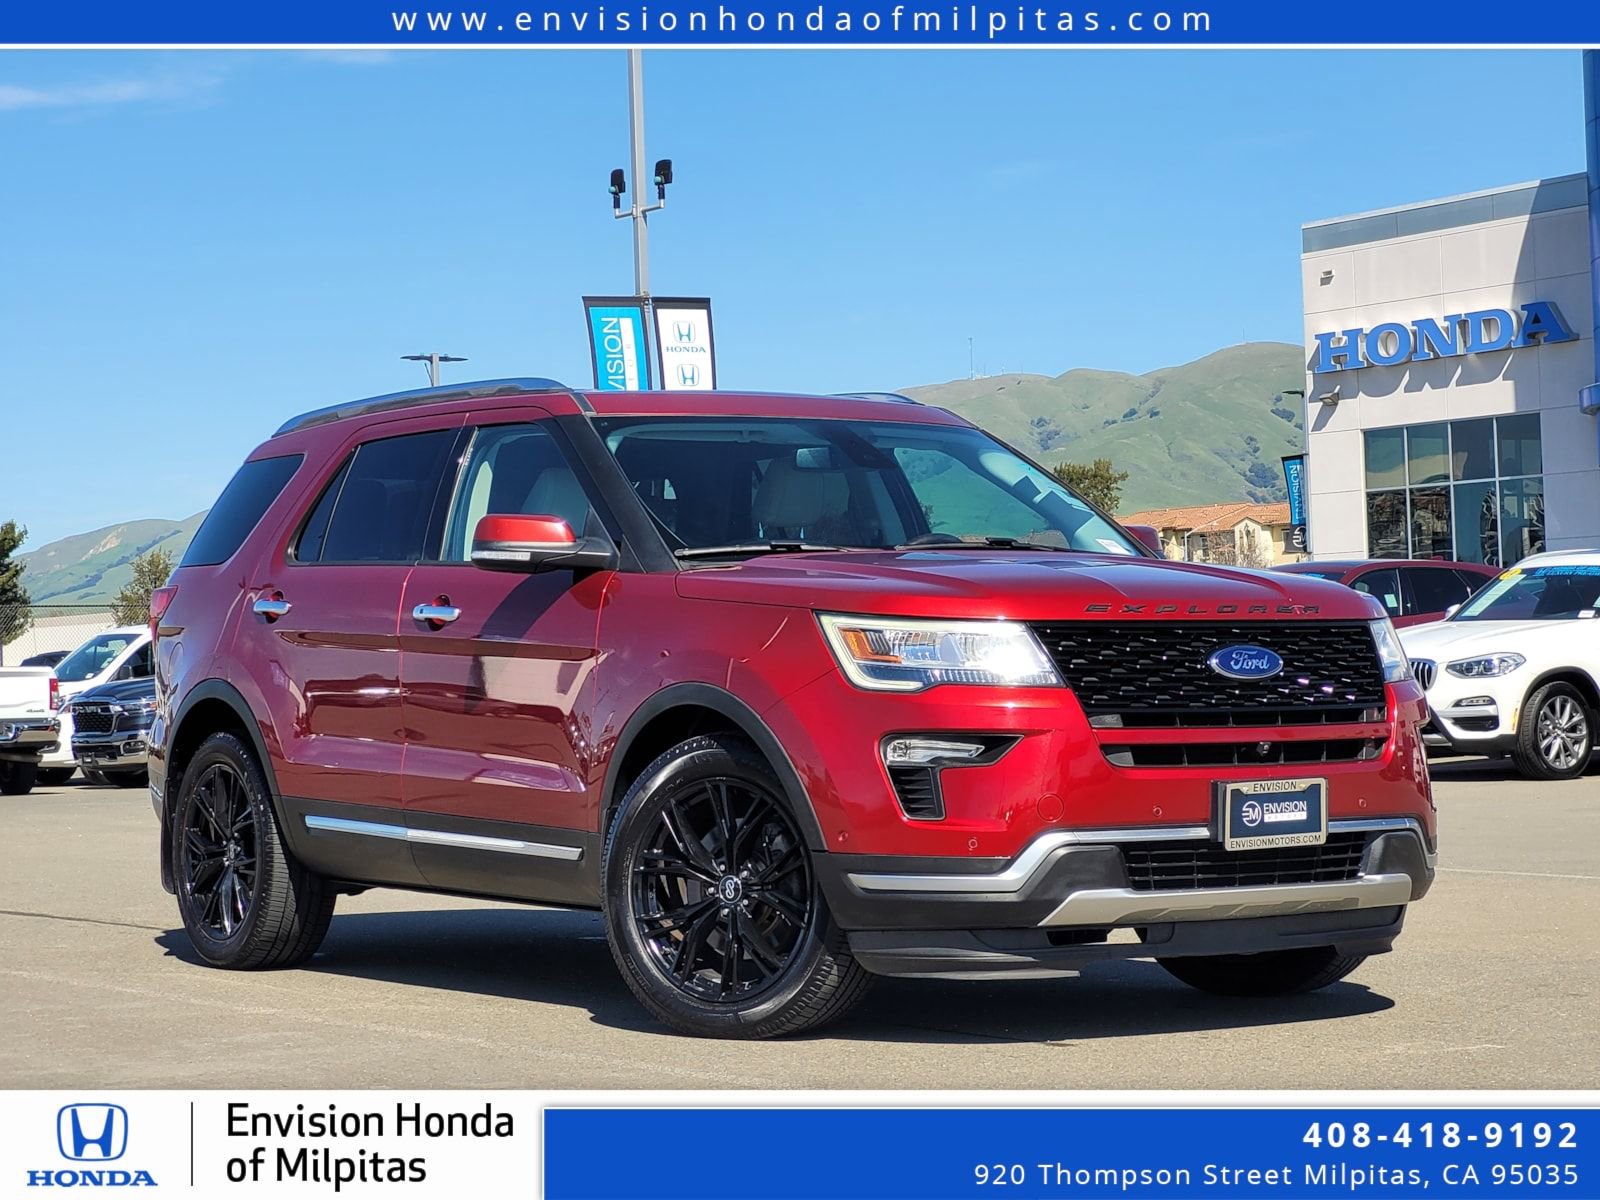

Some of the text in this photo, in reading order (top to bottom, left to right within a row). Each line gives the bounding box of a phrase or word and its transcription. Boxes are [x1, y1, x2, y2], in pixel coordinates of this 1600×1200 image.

[1314, 301, 1573, 374] HONDA
[1084, 603, 1320, 614] EXPLORER
[1230, 649, 1270, 670] Ford
[1253, 781, 1297, 792] ENVISION
[1263, 801, 1307, 814] ENVISION
[1230, 835, 1321, 849] ENVISIONMOTORS.COM
